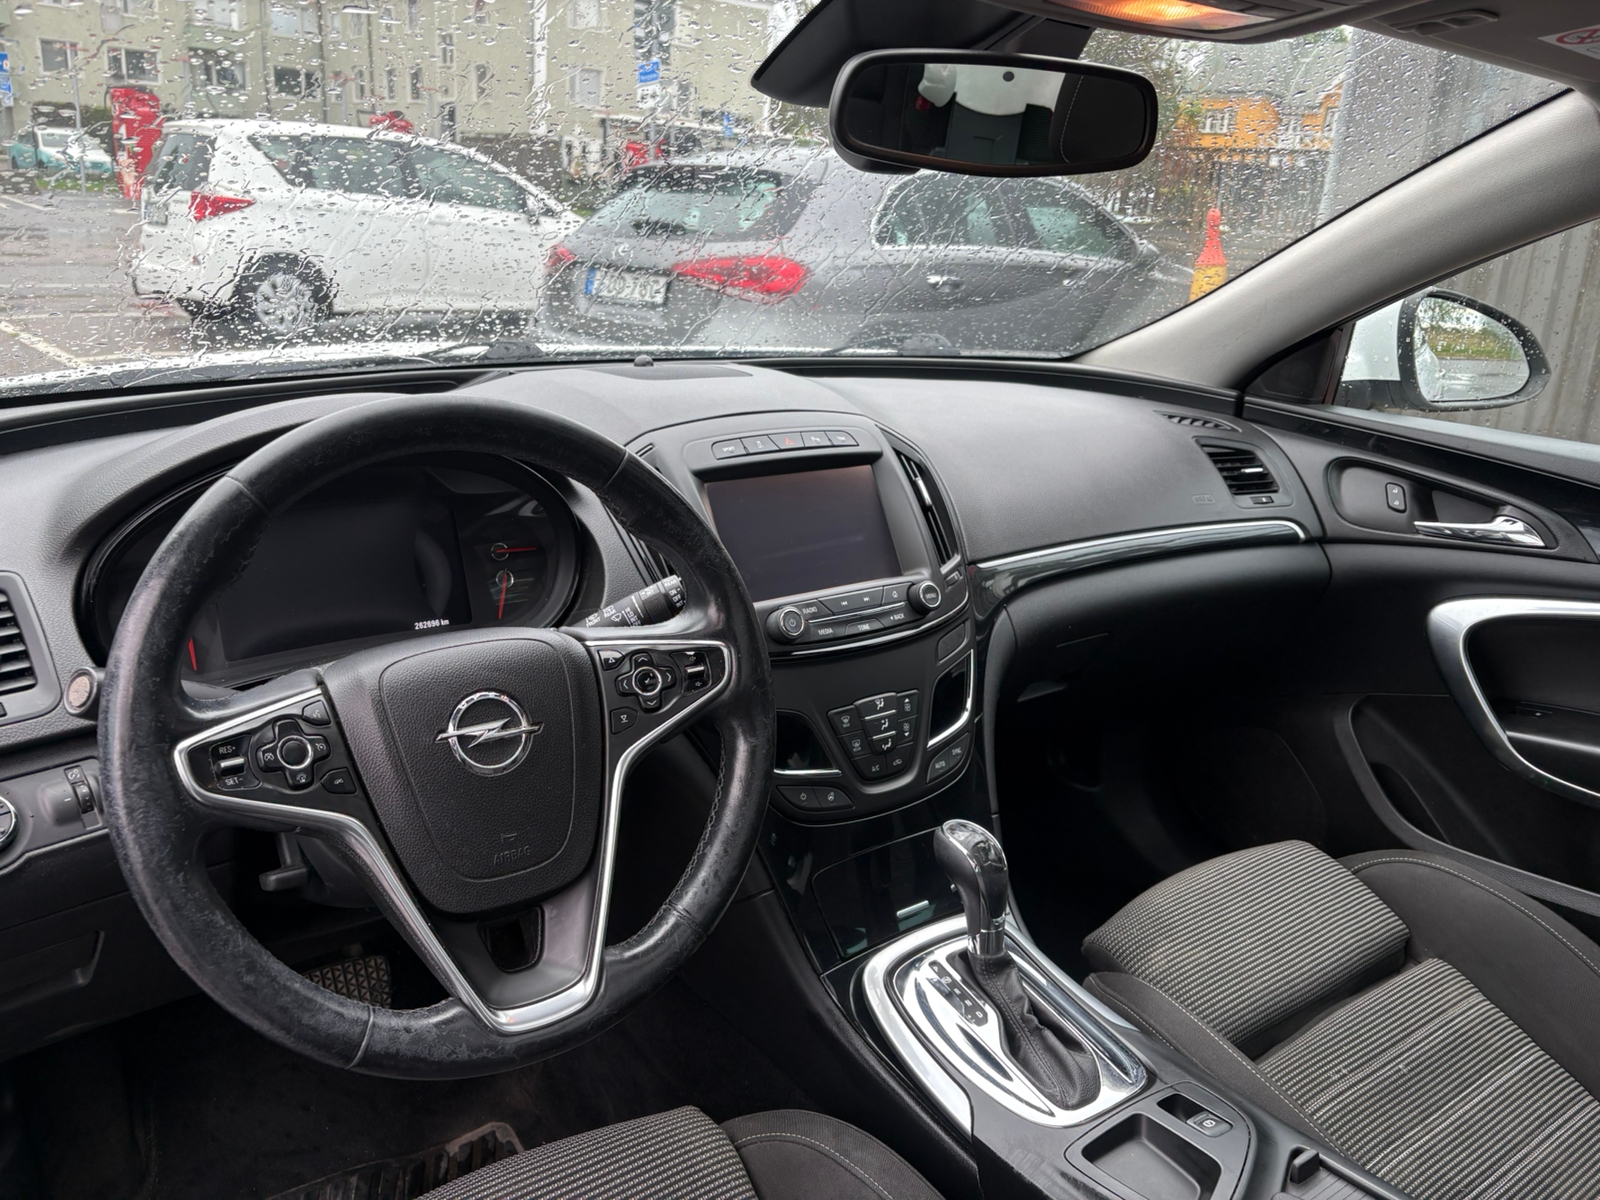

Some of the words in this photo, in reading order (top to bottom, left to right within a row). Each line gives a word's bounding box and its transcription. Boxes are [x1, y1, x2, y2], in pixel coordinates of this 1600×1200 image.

[802, 606, 818, 615] RADIO
[893, 612, 905, 620] BACK
[440, 618, 450, 626] km
[857, 623, 870, 631] TONE
[218, 746, 236, 755] RES+
[951, 747, 962, 756] SYNC
[871, 764, 880, 772] A/C
[934, 760, 946, 769] AUTO
